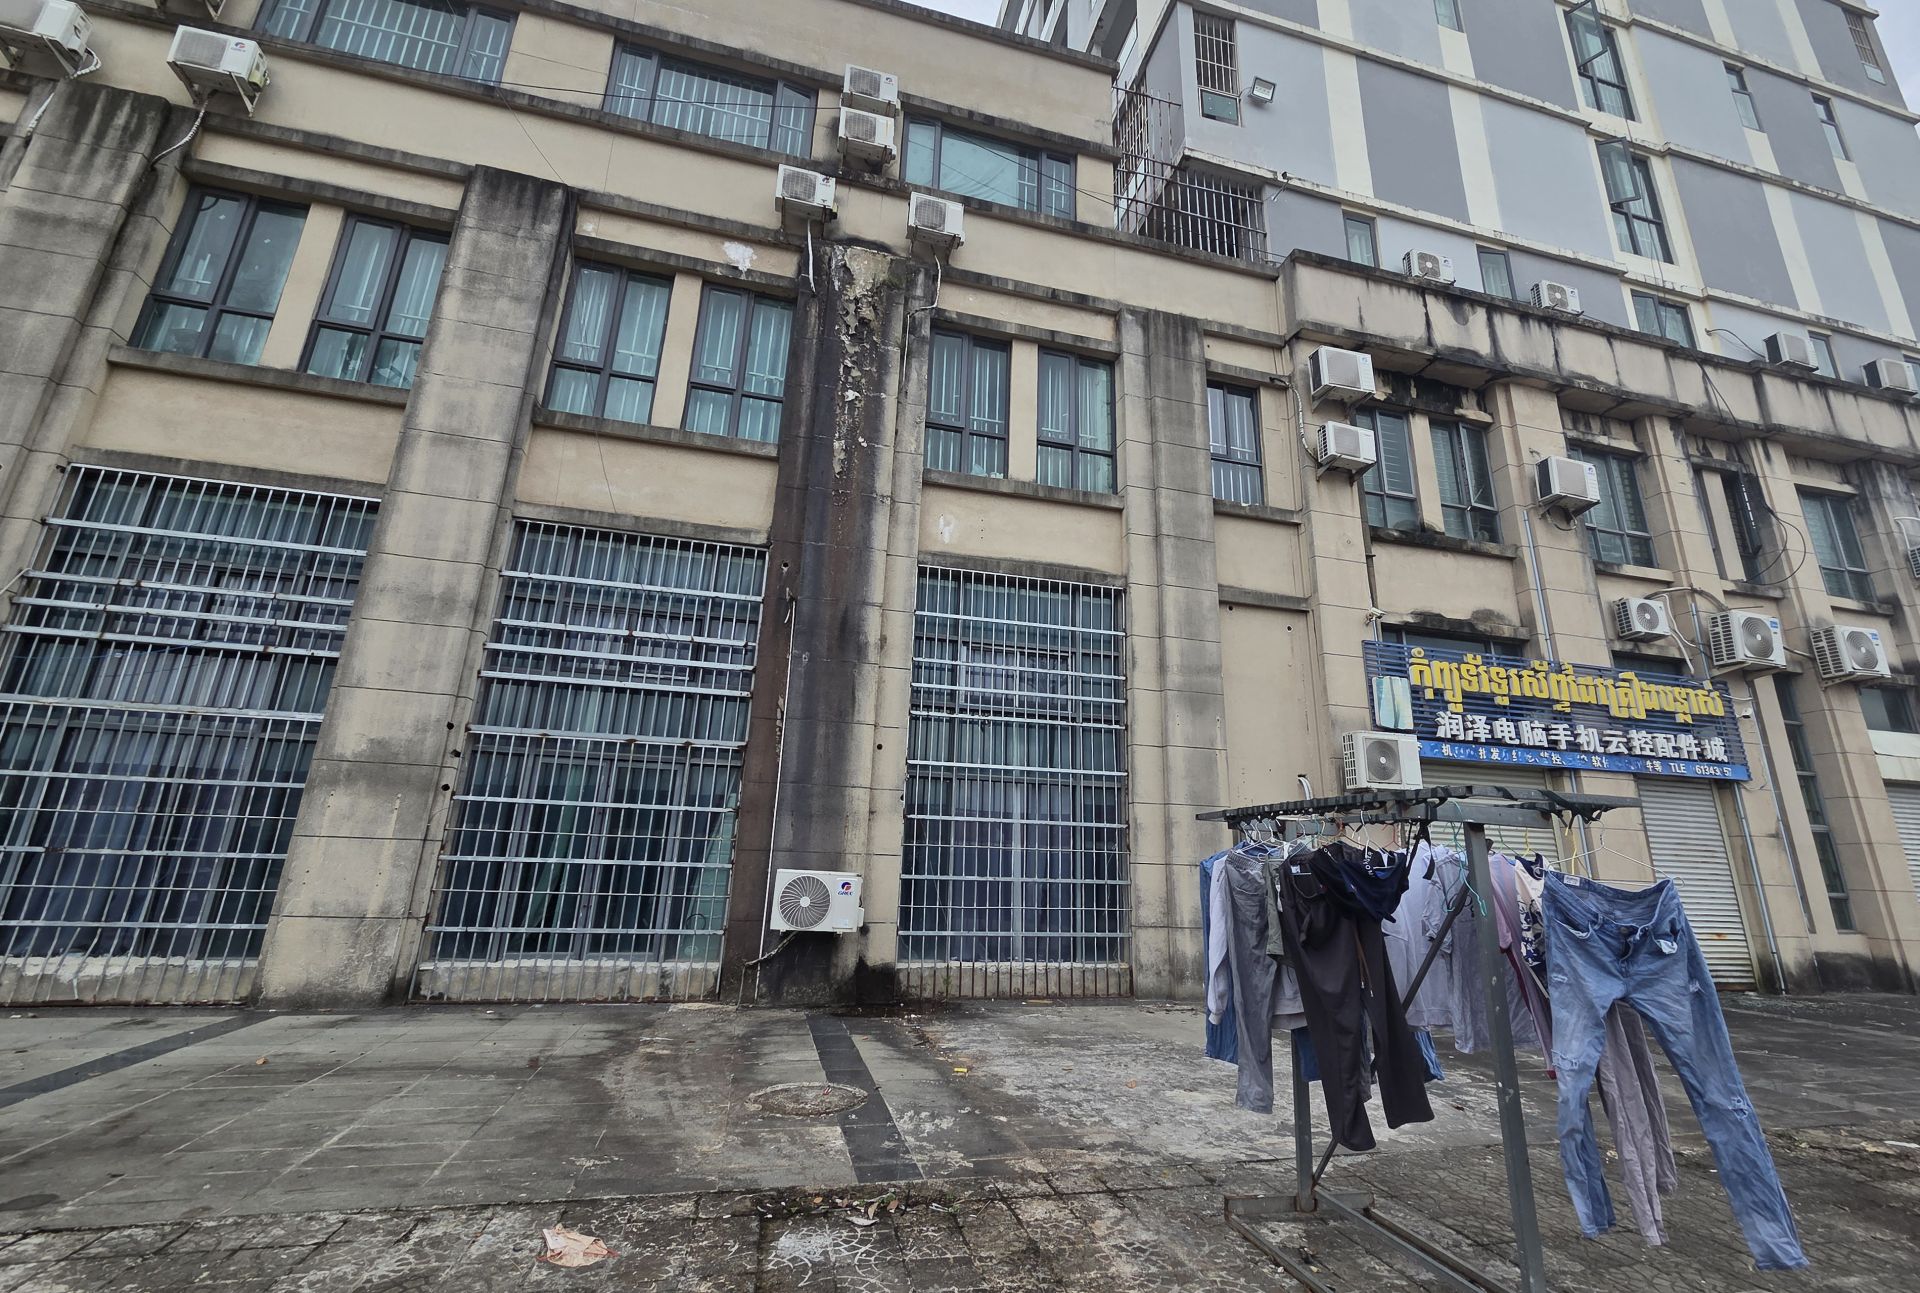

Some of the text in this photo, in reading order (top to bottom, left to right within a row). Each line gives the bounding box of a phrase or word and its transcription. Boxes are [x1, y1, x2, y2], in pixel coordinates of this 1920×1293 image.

[1435, 711, 1728, 762] 润泽电脑手机云控配件城
